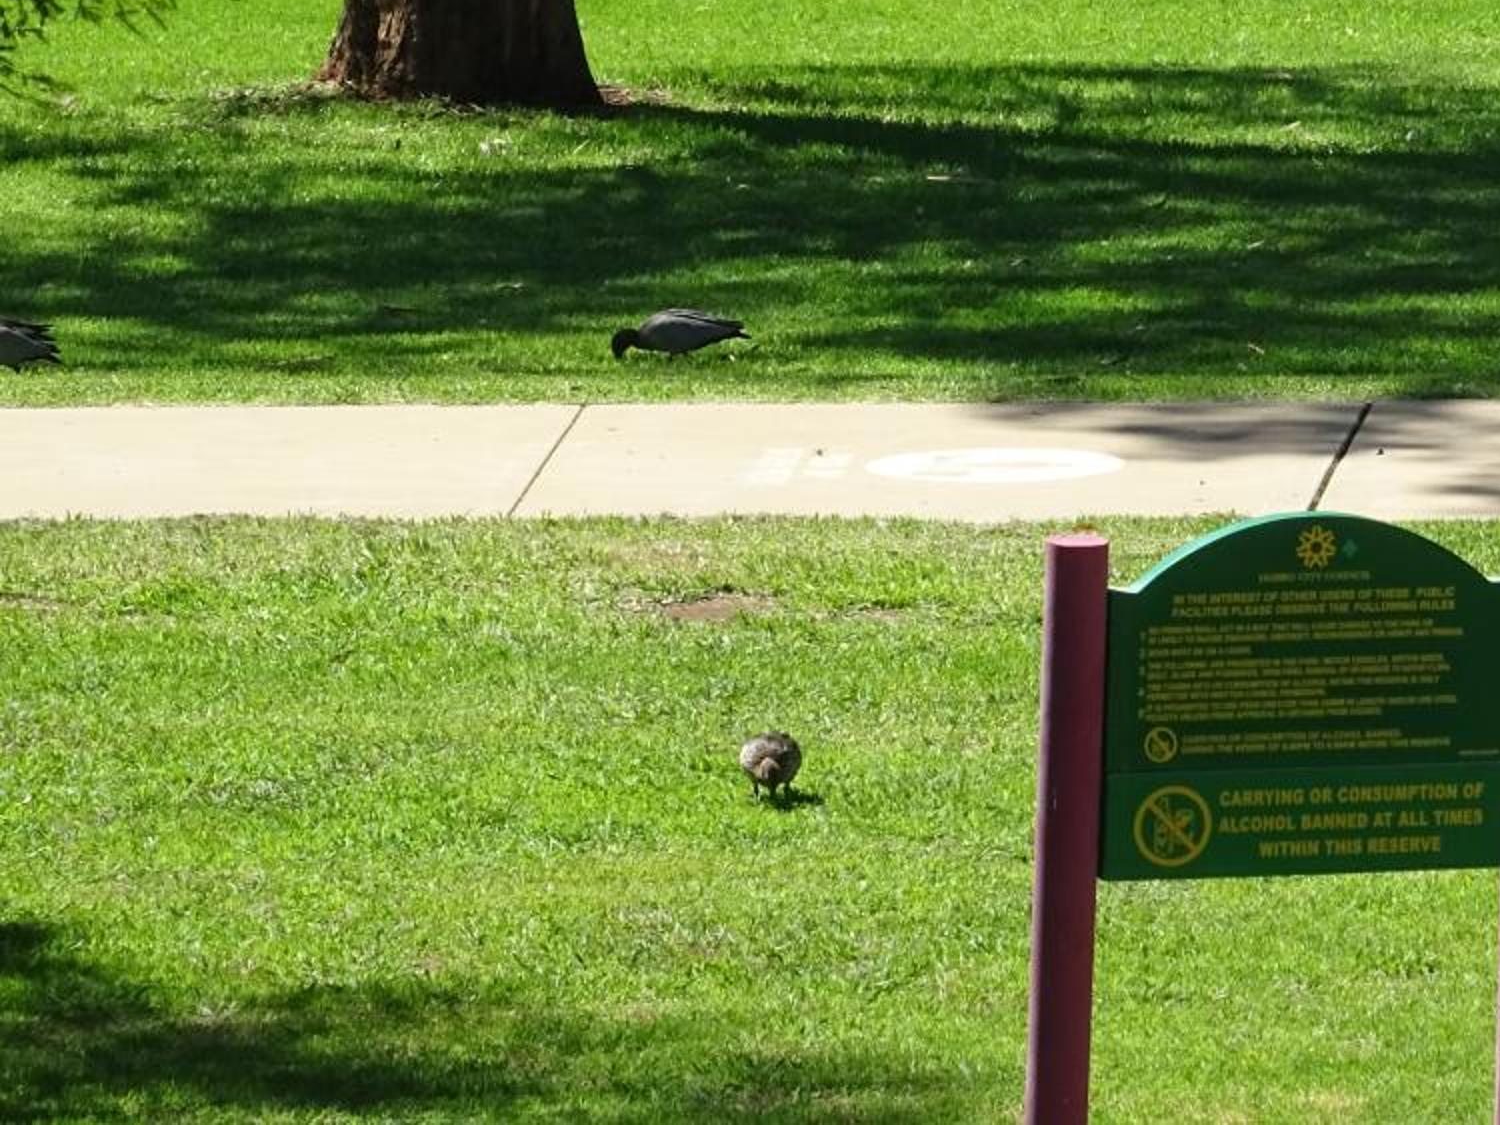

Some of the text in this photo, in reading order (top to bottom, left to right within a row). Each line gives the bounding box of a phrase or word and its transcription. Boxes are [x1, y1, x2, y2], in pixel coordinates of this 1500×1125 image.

[1415, 586, 1455, 598] PUBLIC
[1218, 781, 1485, 807] CARRYING OR CONSUMPTION OF
[1217, 808, 1483, 833] ALCOHOL BANNED AT ALL TIMES
[1258, 835, 1441, 858] WITHIN THIS RESERVE
